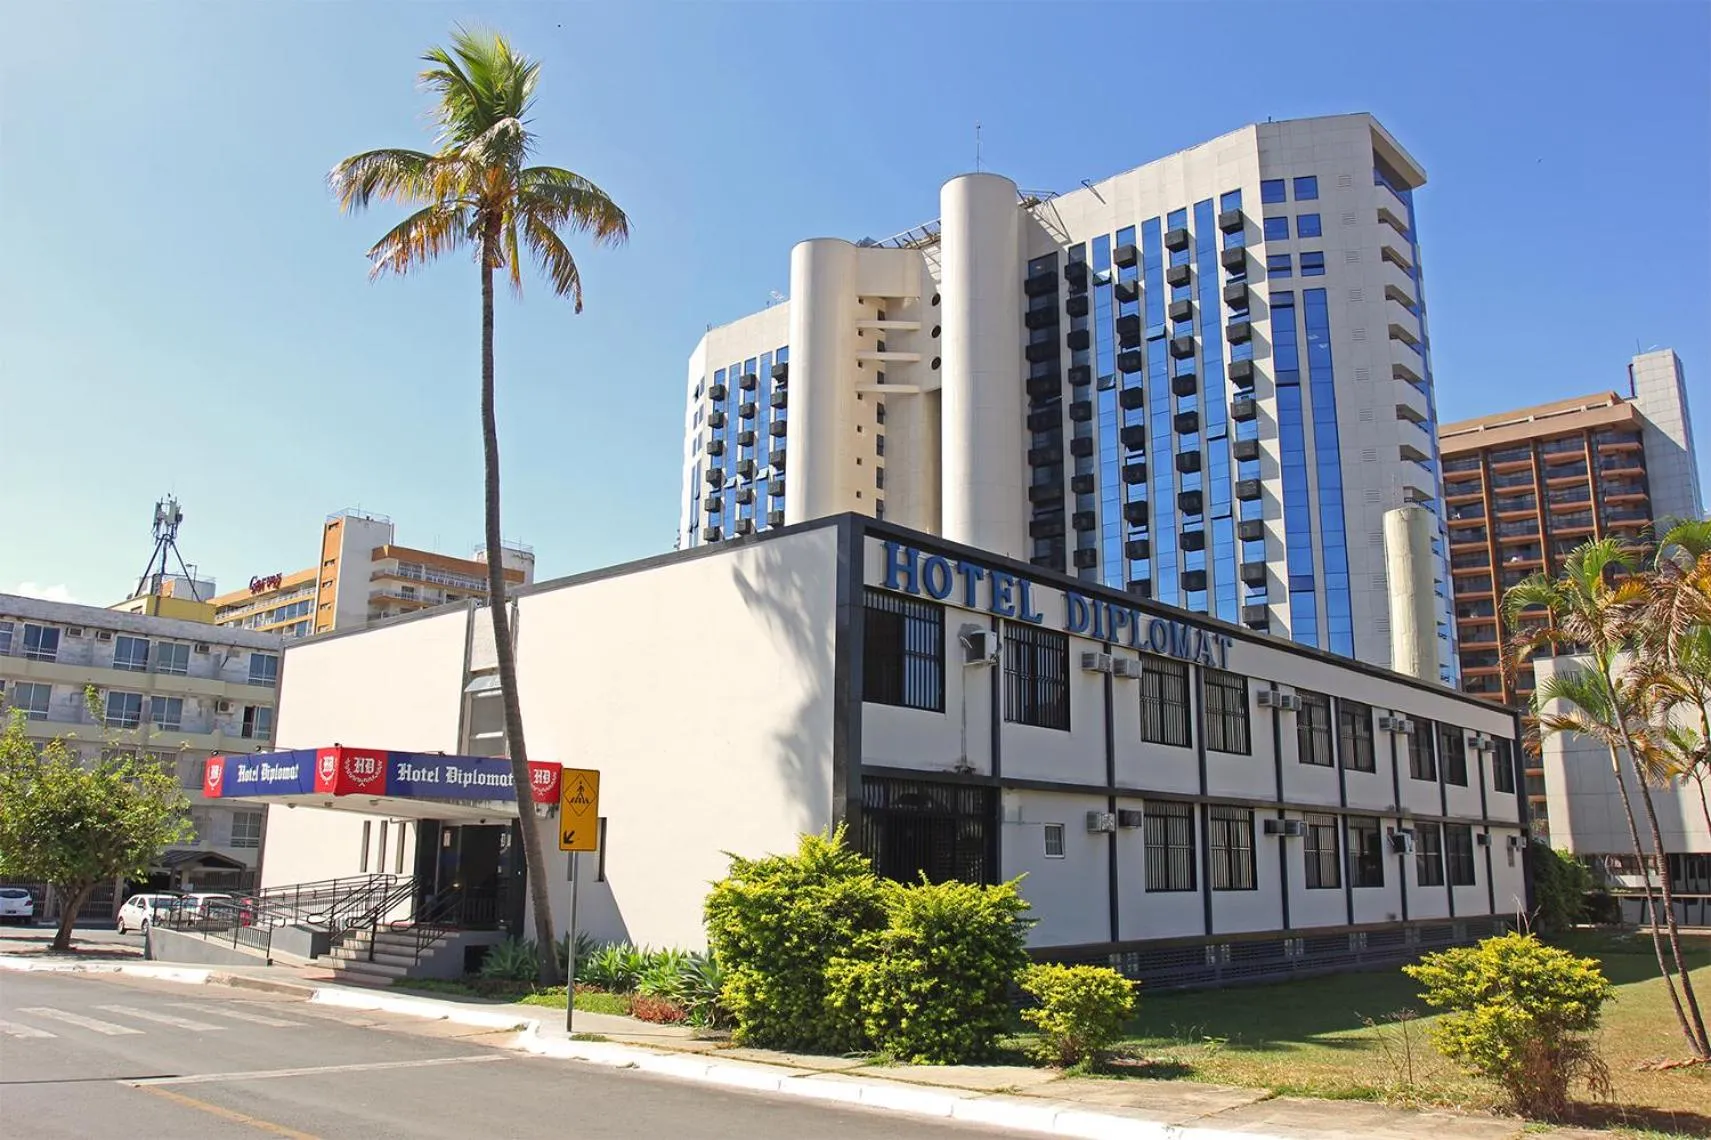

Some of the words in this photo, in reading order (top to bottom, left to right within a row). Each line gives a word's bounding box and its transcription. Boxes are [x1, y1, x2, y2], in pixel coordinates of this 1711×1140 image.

[884, 540, 1043, 624] HOTEL
[1064, 590, 1233, 669] DIPLOMAT
[237, 764, 258, 783] Hotel
[261, 763, 299, 785] Diplomat
[397, 763, 439, 783] Hotel
[446, 766, 514, 788] Diplomat
